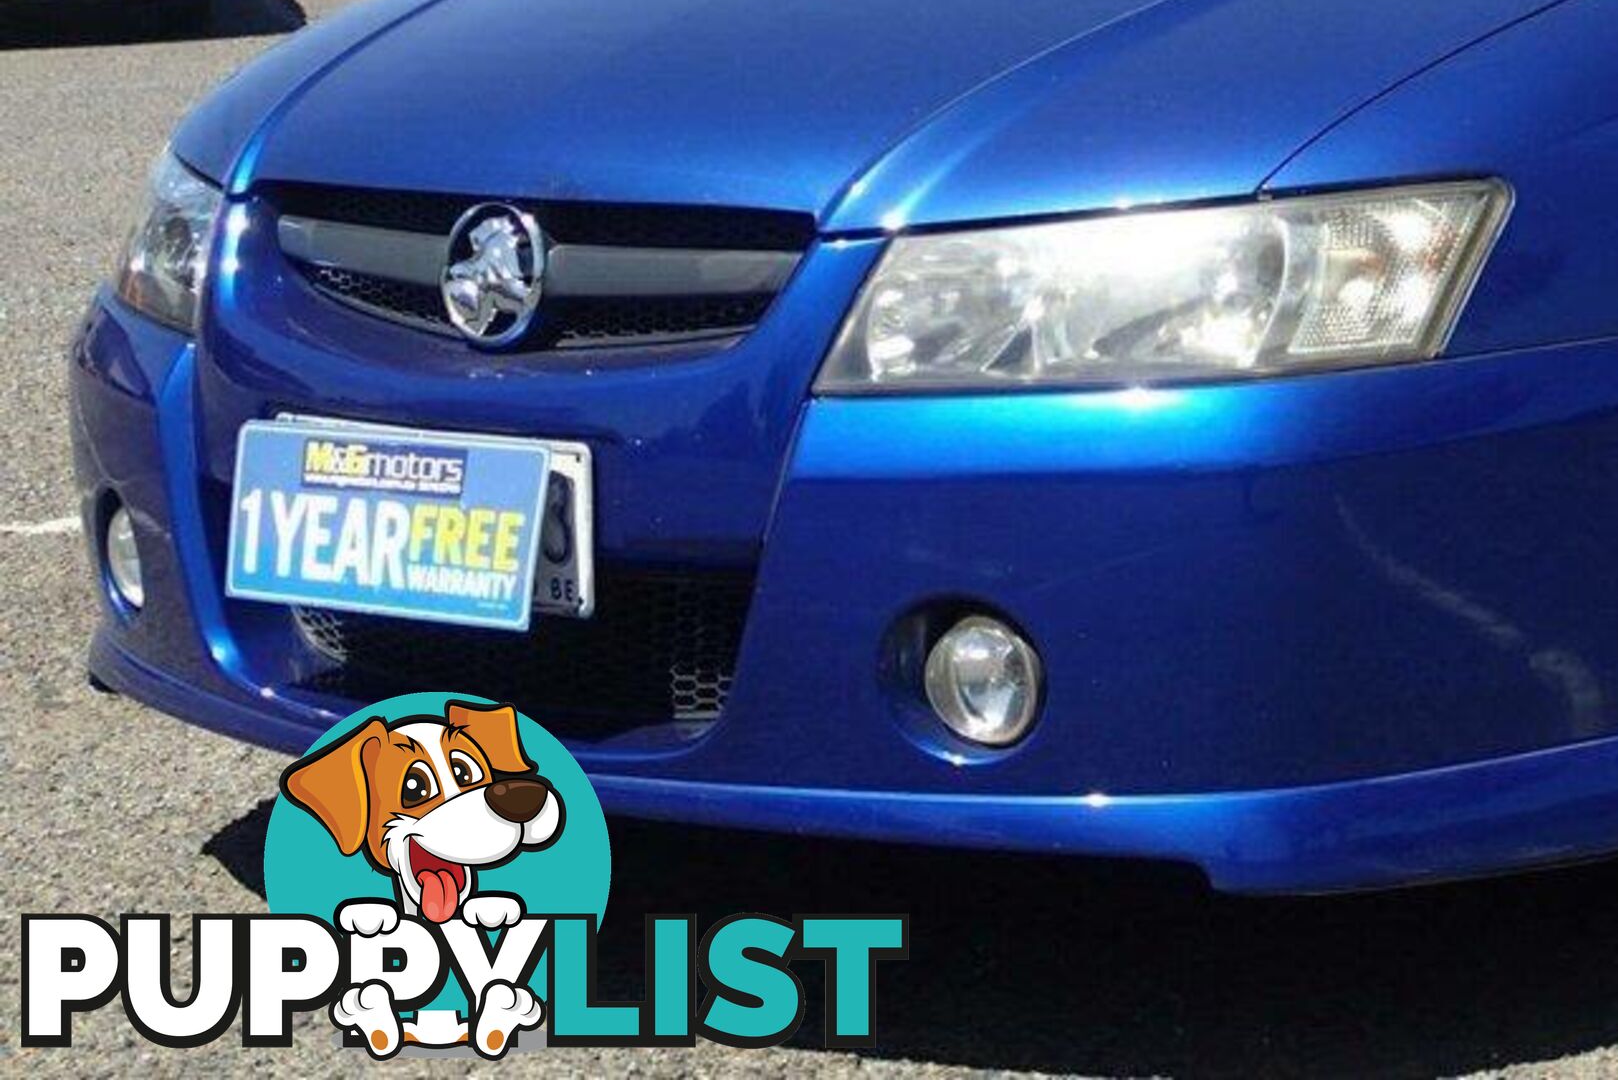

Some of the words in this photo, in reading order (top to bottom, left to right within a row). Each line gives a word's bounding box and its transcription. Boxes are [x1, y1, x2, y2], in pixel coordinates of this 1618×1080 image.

[241, 488, 262, 574] 1
[270, 490, 411, 589] YEAR
[409, 504, 525, 572] FREE
[408, 563, 517, 600] WARRANTY
